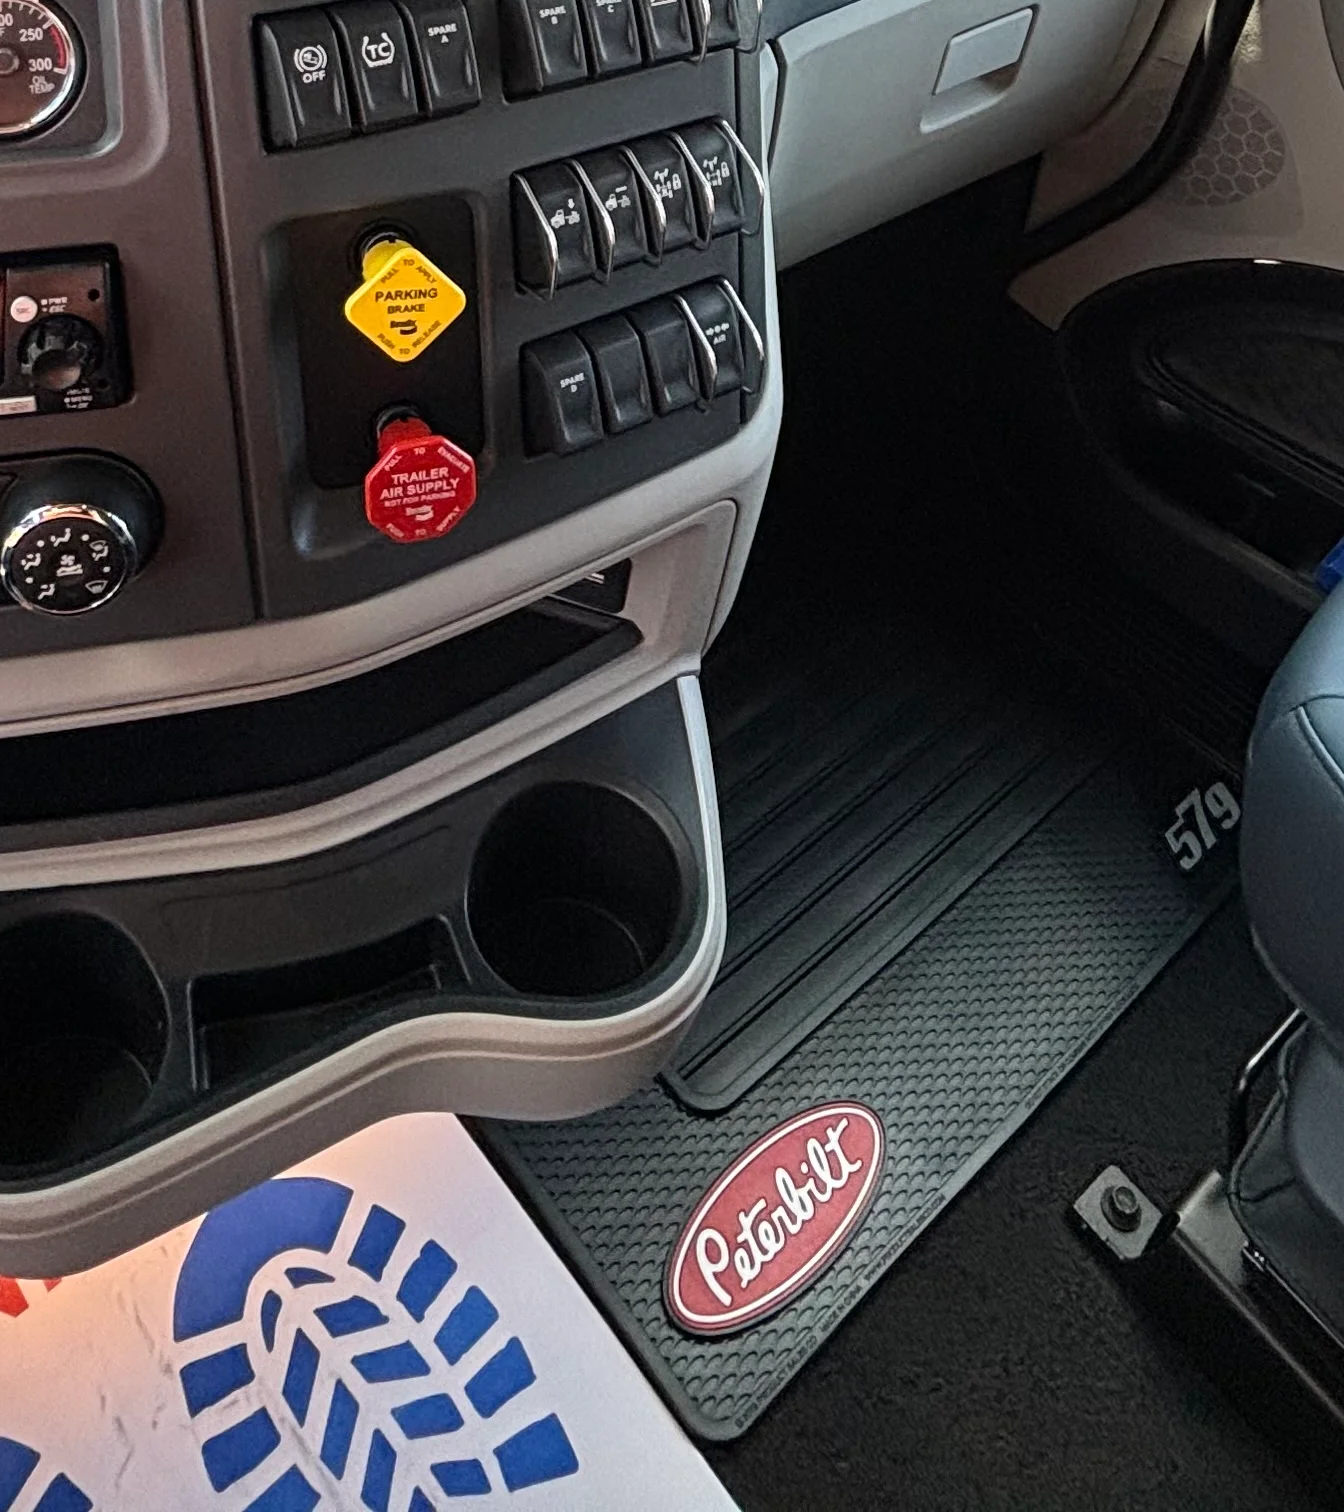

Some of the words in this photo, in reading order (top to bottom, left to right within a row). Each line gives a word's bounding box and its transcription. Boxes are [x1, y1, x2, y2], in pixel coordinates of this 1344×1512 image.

[539, 6, 566, 18] SPARE
[607, 4, 615, 13] C
[19, 28, 43, 42] 250
[427, 23, 458, 37] SPARE
[440, 35, 449, 44] A
[366, 42, 391, 59] TC
[28, 57, 52, 72] 300
[32, 76, 46, 86] OIL
[302, 70, 326, 84] OFF
[29, 83, 55, 95] TEMP
[380, 268, 400, 284] PULL
[416, 266, 437, 284] APPLY
[375, 288, 438, 303] PARKING
[387, 303, 425, 315] BRAKE
[412, 320, 442, 348] RELEASE
[560, 373, 585, 388] SPARE
[570, 384, 578, 393] D
[384, 455, 403, 471] PULL
[413, 447, 426, 455] TO
[391, 467, 450, 485] TRAILER
[379, 486, 404, 500] AIR
[406, 477, 460, 496] SUPPLY
[384, 499, 402, 508] NOT
[402, 496, 419, 505] FOR
[420, 491, 456, 502] PARKING
[1164, 781, 1241, 870] 579
[695, 1116, 864, 1307] Peterbilt
